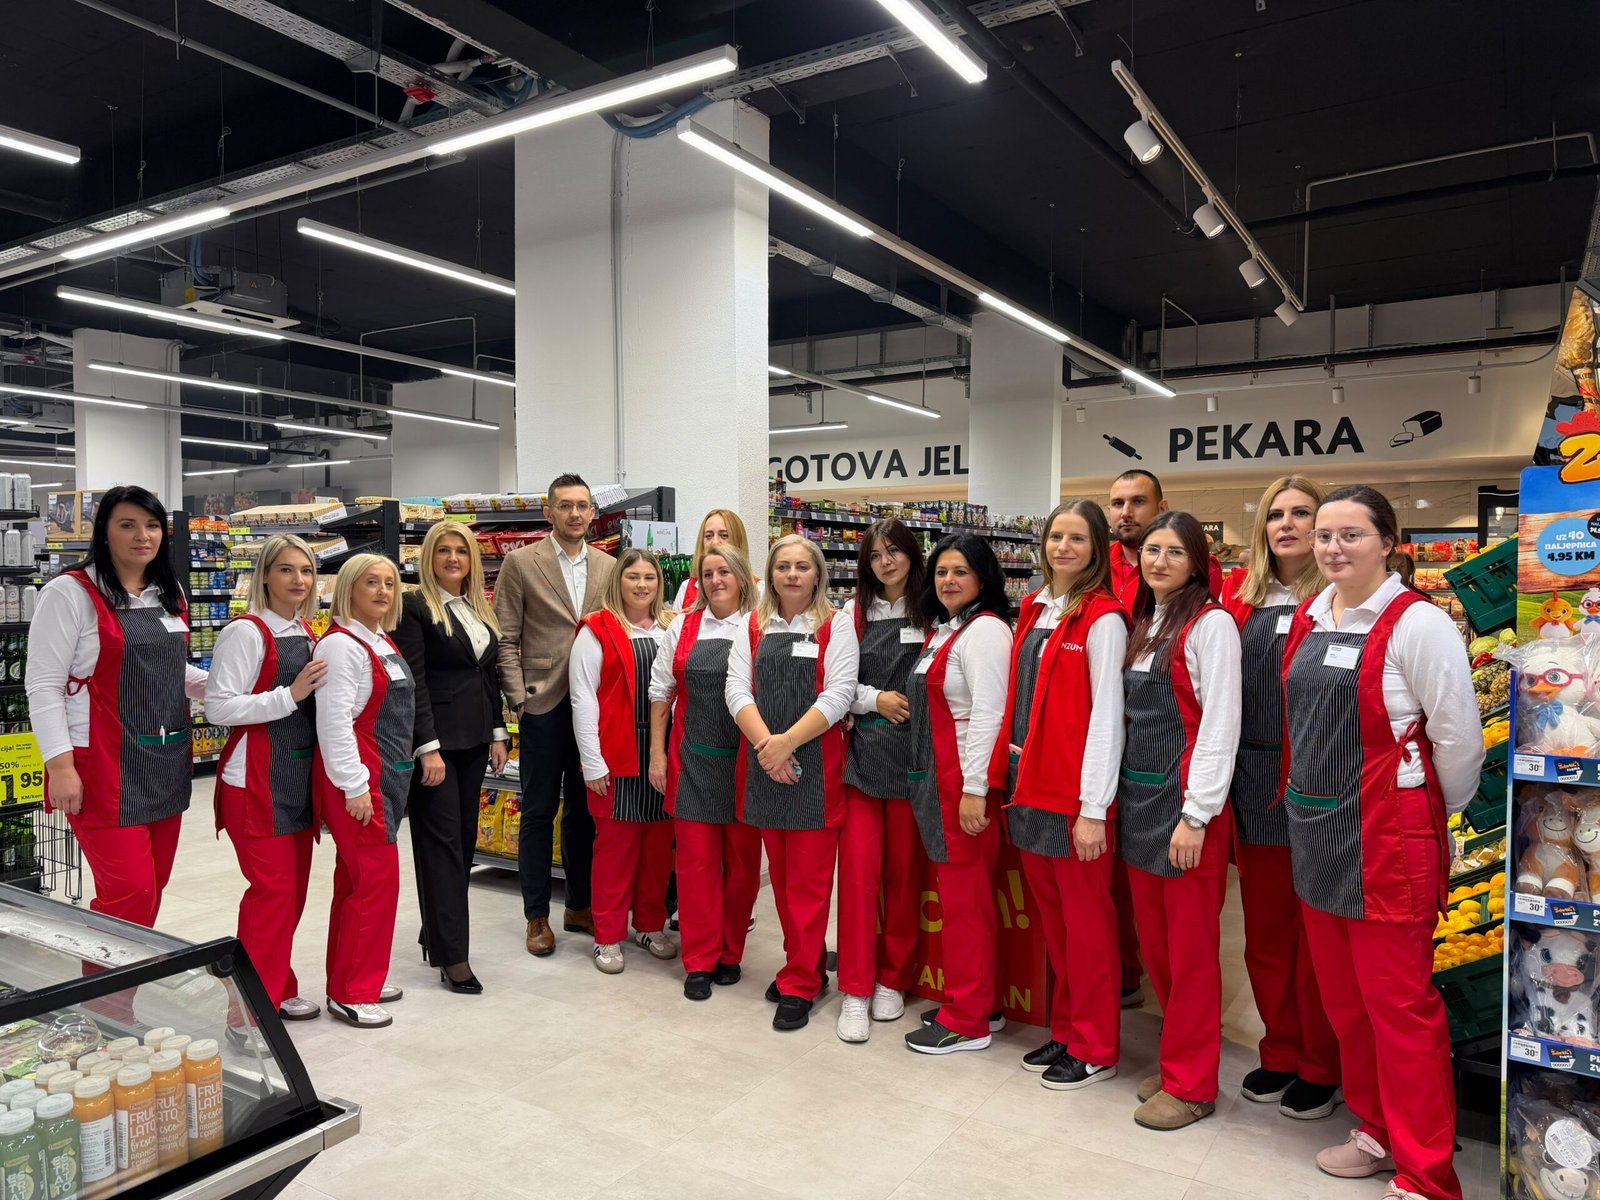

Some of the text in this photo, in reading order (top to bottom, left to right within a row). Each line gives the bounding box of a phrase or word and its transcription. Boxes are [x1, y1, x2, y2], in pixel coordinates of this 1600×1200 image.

[1169, 416, 1365, 463] PEKARA
[769, 445, 969, 484] GOTOVA JEL
[1568, 530, 1584, 540] 40
[1575, 550, 1595, 560] KM
[1529, 763, 1539, 771] 30
[1, 771, 43, 805] 1 95
[1529, 903, 1539, 911] 30
[1524, 1048, 1535, 1057] 30
[157, 1096, 177, 1110] RUL
[158, 1109, 177, 1121] ATO
